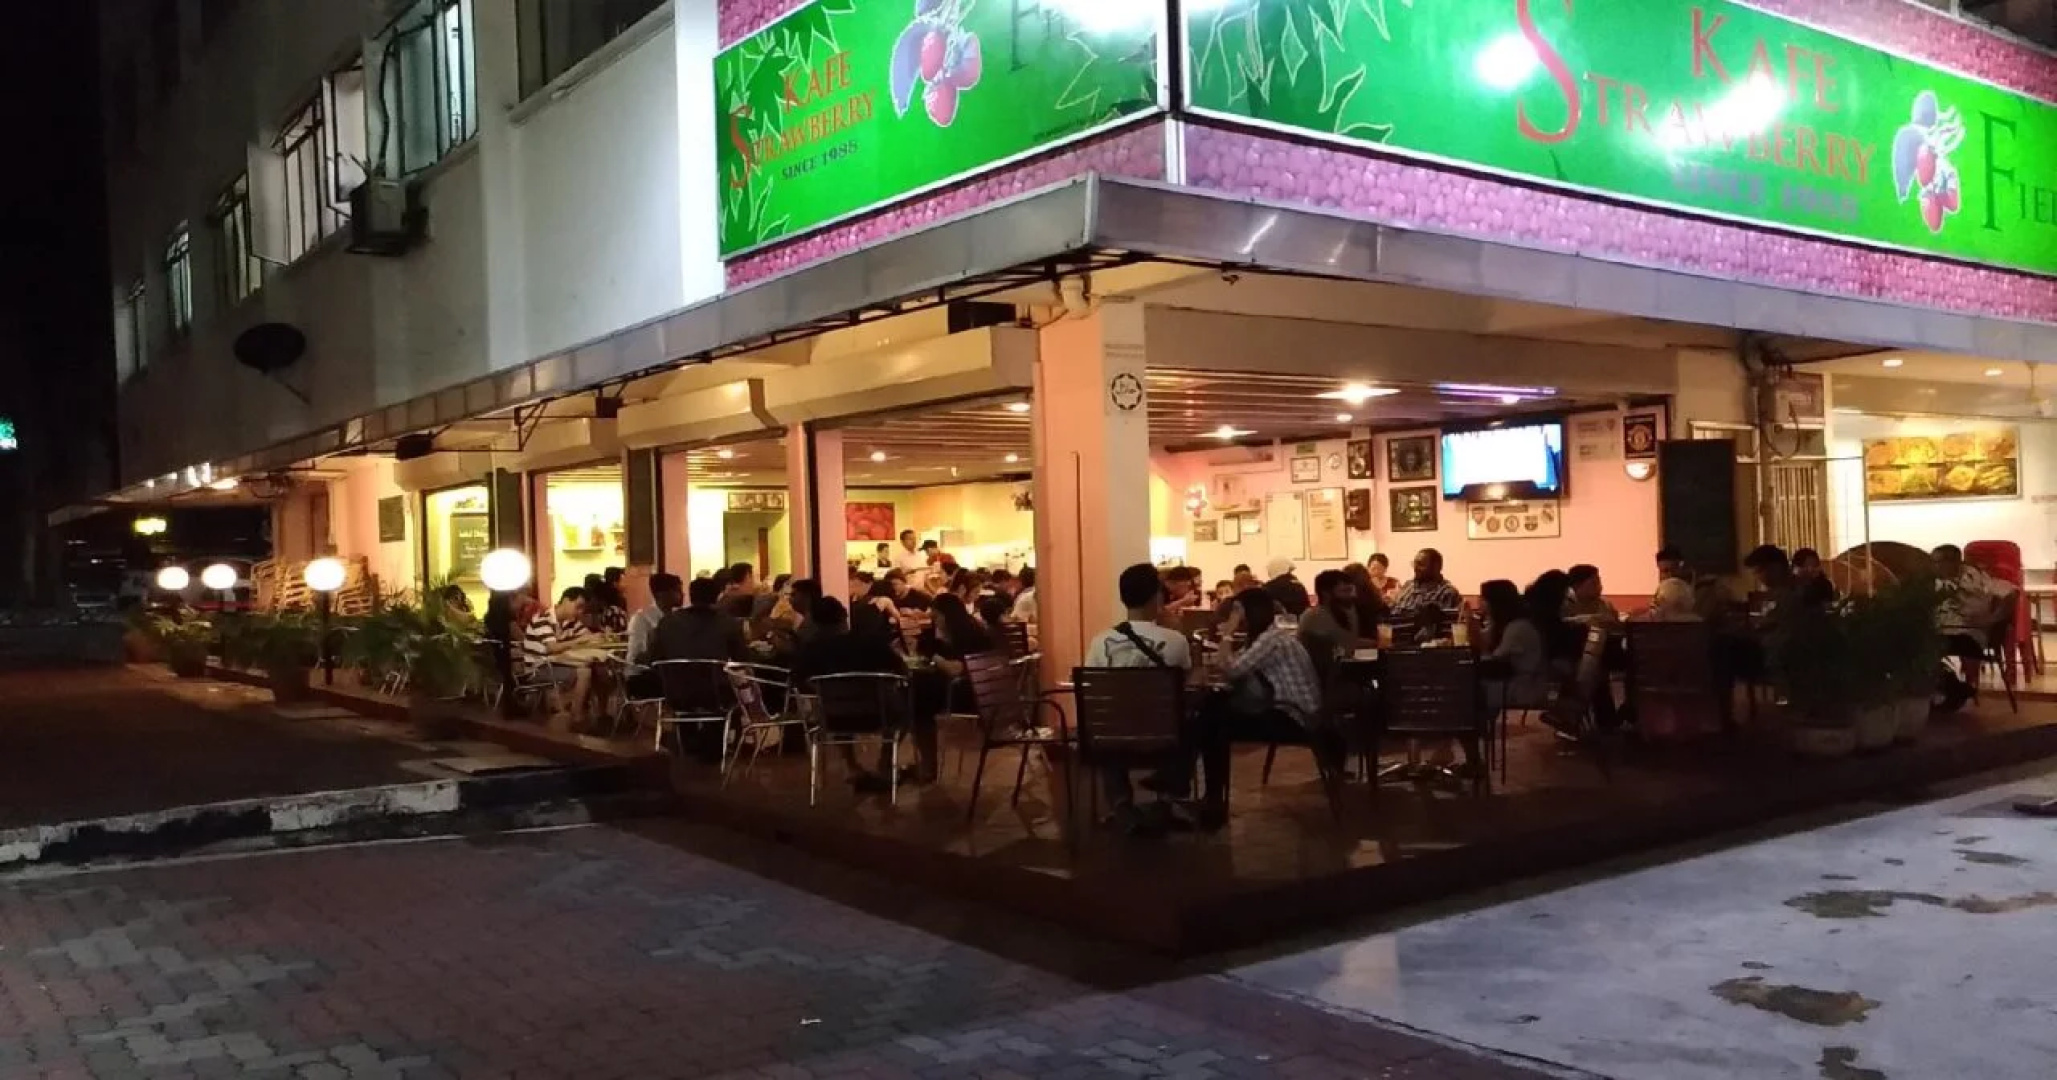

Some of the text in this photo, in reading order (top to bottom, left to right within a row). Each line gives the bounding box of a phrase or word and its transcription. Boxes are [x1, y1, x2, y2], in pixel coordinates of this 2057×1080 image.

[782, 50, 852, 115] KAFE
[1690, 7, 1838, 113] KAFE
[729, 87, 877, 189] STRAWBERRY
[781, 140, 858, 180] SINCE 1988
